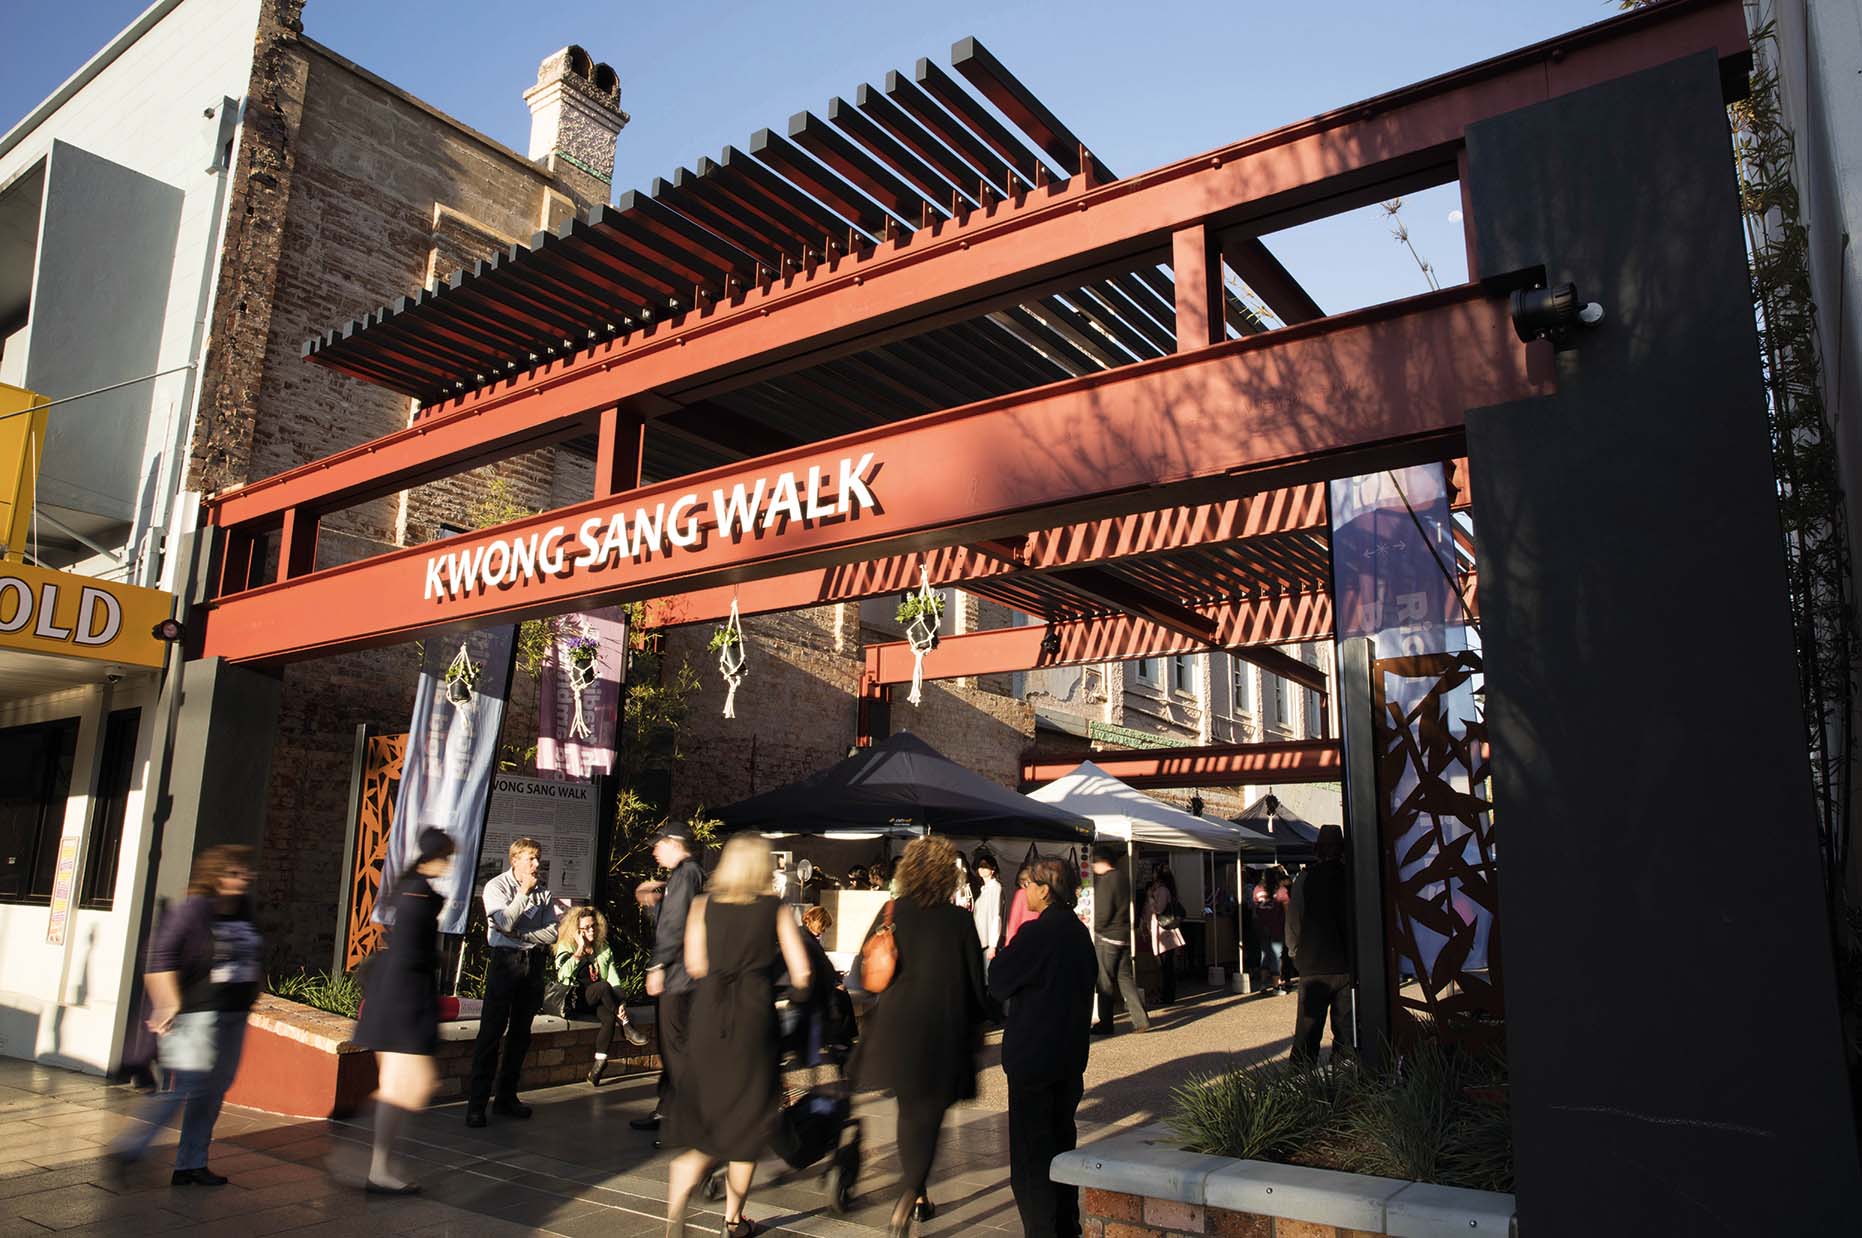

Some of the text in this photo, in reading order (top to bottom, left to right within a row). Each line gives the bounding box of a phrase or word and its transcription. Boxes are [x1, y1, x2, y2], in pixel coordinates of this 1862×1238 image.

[424, 452, 875, 600] KWONG SANG WALK
[0, 576, 122, 646] OLD
[526, 783, 556, 797] SANG
[558, 786, 588, 800] WALK
